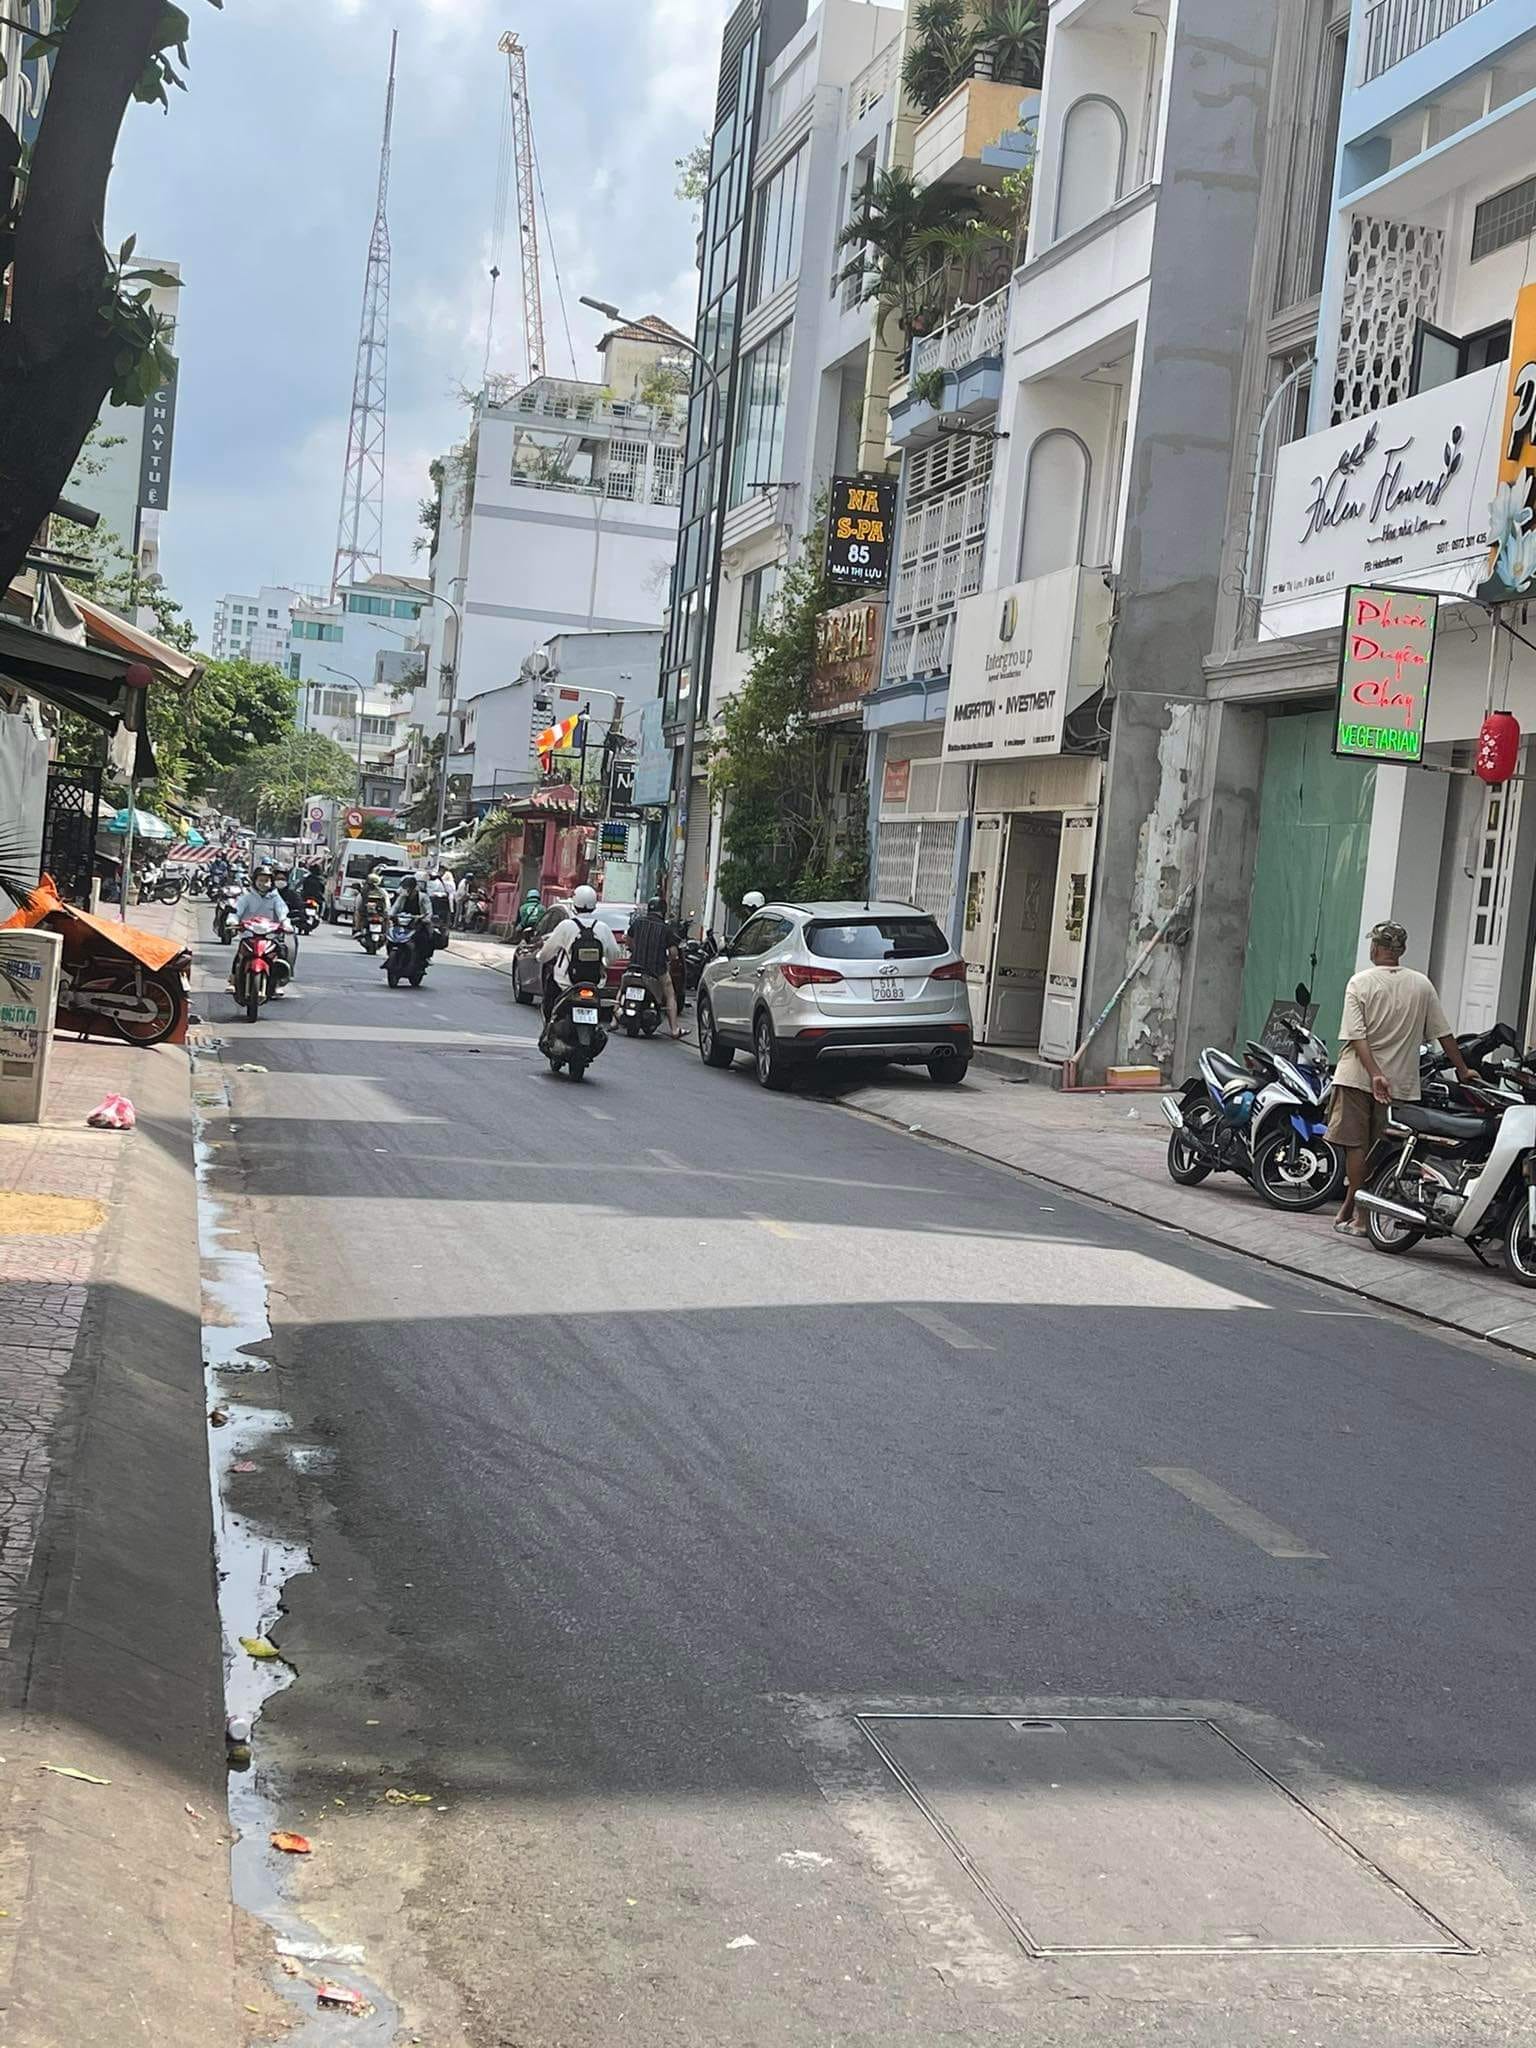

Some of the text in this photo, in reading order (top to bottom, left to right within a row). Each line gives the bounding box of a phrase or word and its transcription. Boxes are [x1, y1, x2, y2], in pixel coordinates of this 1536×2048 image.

[847, 488, 879, 513] NA
[847, 544, 870, 564] 85
[832, 564, 849, 574] MAI
[985, 649, 1033, 673] Intergroup
[1005, 690, 1056, 715] INVESTMENT
[1352, 678, 1415, 729] Chay
[1340, 724, 1420, 753] VEGETARIAN
